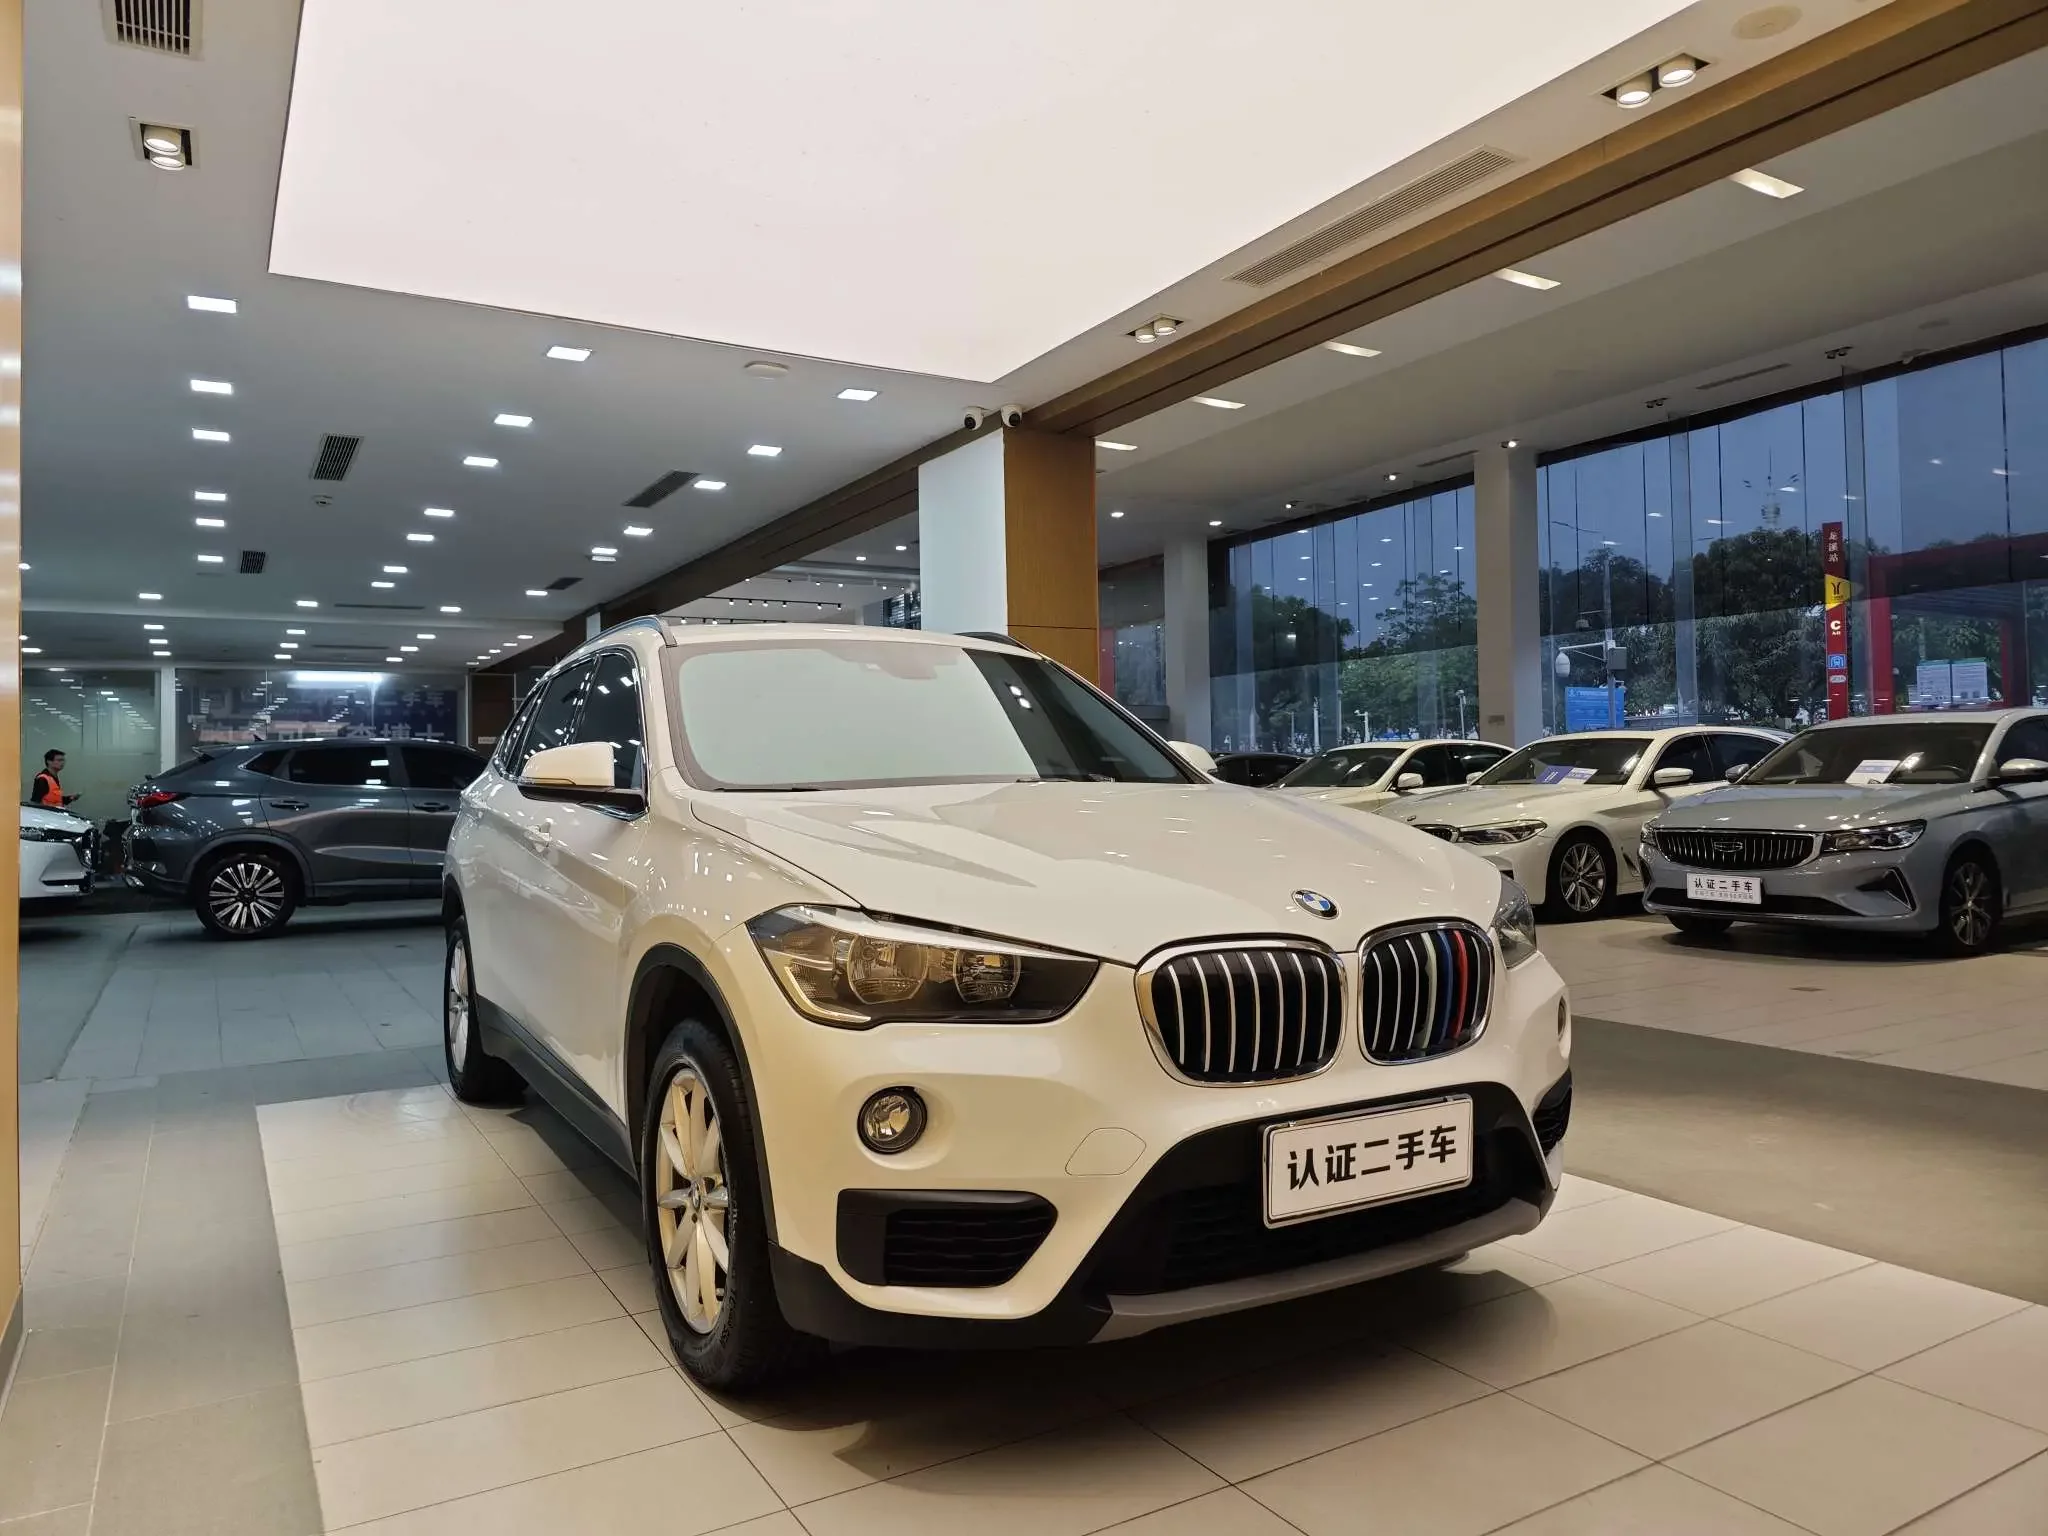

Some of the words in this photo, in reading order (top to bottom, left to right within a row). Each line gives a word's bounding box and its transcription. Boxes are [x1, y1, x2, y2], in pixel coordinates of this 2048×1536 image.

[1830, 620, 1841, 630] C
[1694, 877, 1753, 892] 认证二手车
[1287, 1125, 1457, 1190] 认证二手车
